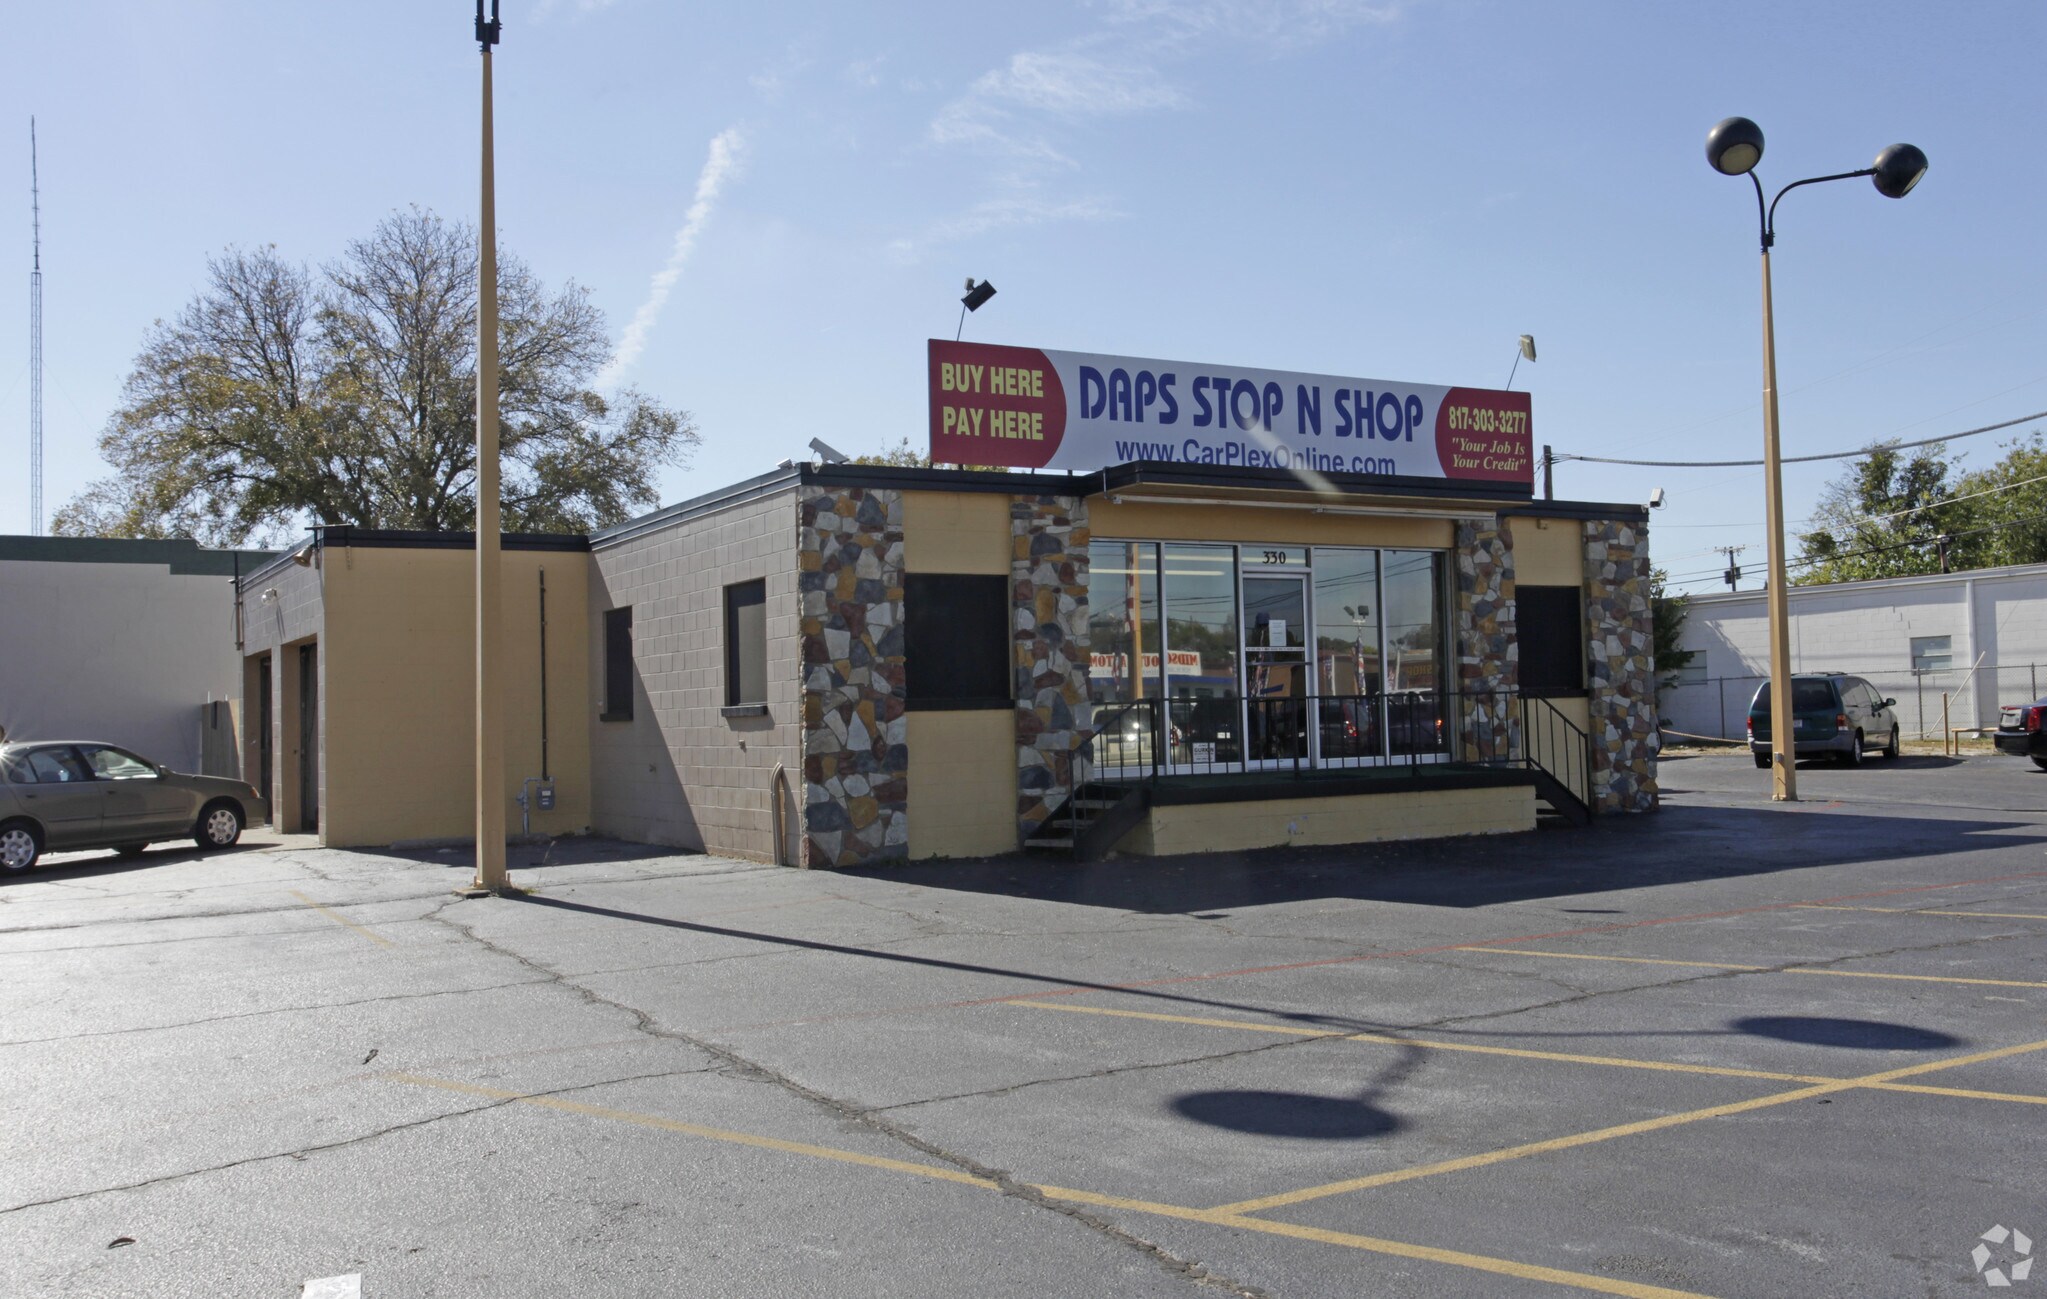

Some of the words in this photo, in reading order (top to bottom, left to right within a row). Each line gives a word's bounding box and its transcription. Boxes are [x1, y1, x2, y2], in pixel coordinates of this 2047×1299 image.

[941, 362, 984, 393] BUY
[990, 366, 1044, 398] HERE
[1079, 365, 1179, 425] DAPS
[1192, 376, 1283, 432] STOP
[1297, 384, 1321, 436] N
[1334, 389, 1423, 442] SHOP
[942, 406, 984, 437] PAY
[990, 410, 1044, 440] HERE
[1448, 405, 1527, 434] 817-303-3277
[1115, 439, 1396, 475] www.CarPlexOnline.com
[1452, 437, 1487, 453] "Your
[1489, 440, 1511, 455] Job
[1515, 443, 1526, 456] Is
[1452, 454, 1480, 469] Your
[1482, 456, 1527, 471] Credit"
[1262, 550, 1286, 564] 330
